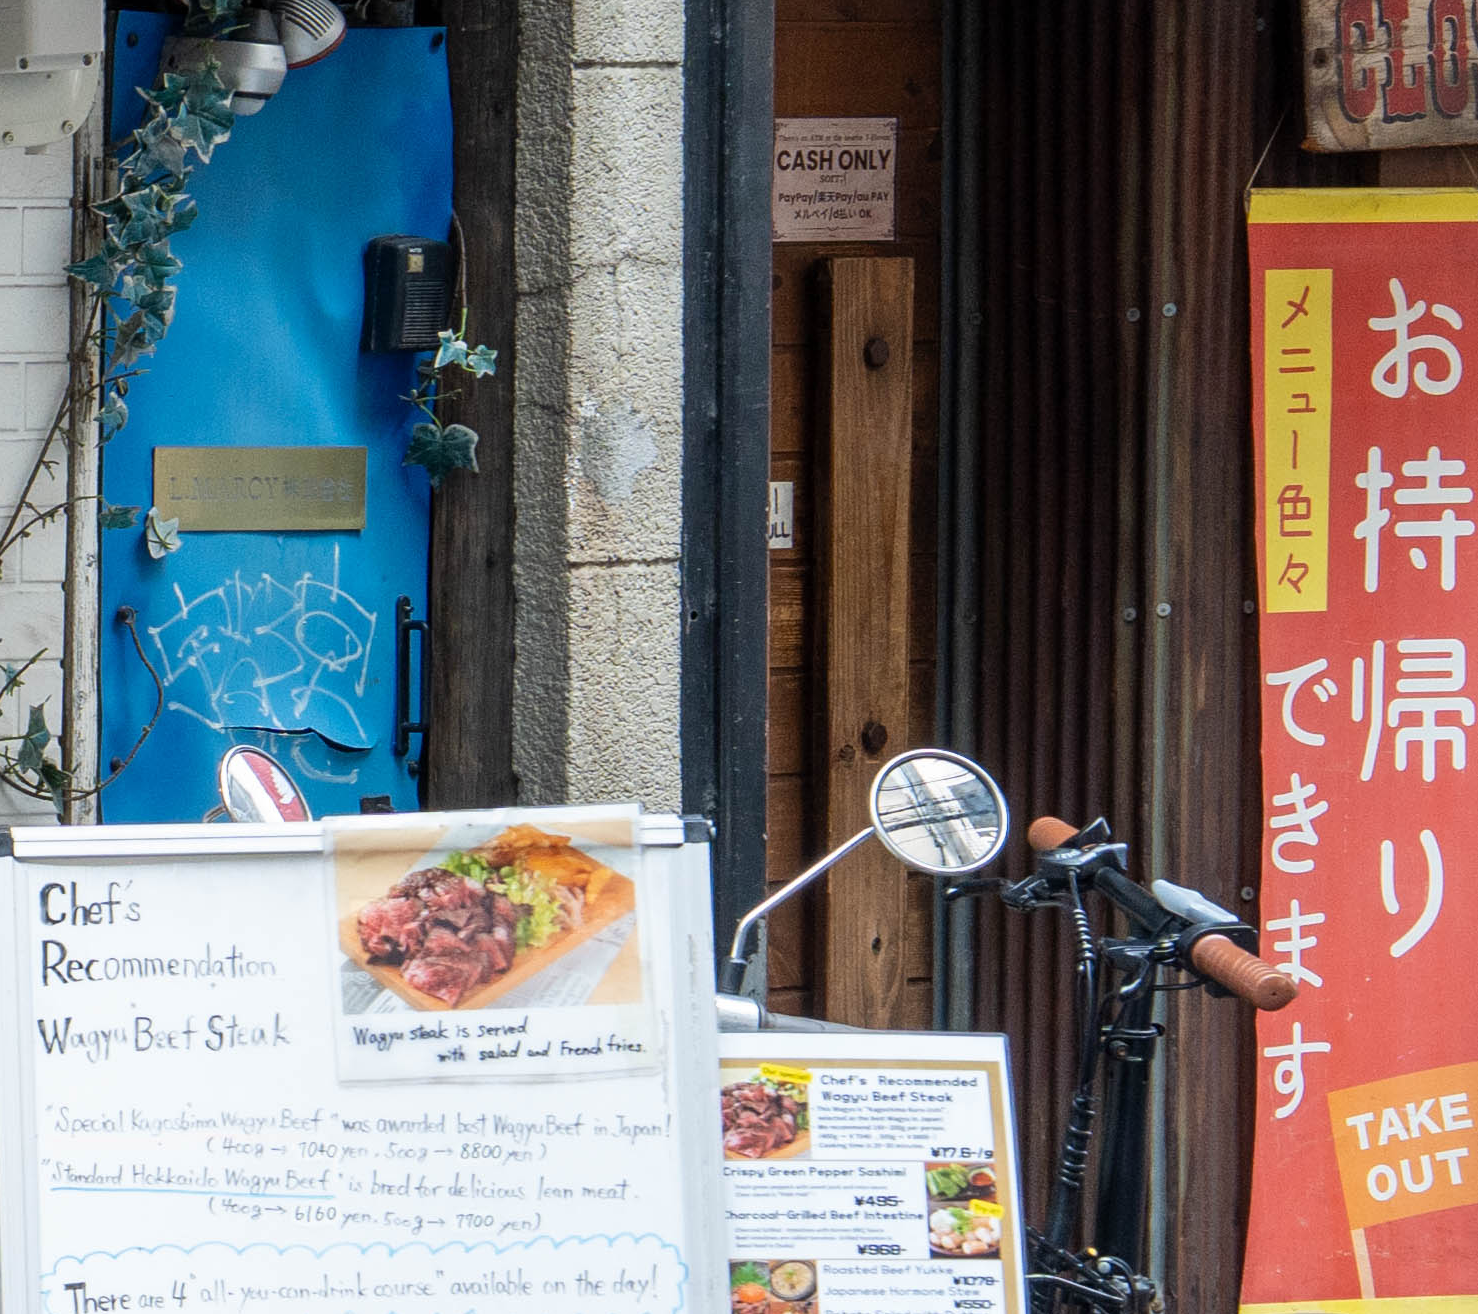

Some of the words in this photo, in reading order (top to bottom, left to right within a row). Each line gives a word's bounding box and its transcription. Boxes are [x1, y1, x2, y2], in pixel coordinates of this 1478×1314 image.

[777, 150, 833, 170] CASH
[838, 150, 891, 170] ONLY
[1276, 286, 1316, 593] メニュー色々
[1352, 277, 1475, 957] お持帰り
[1265, 657, 1337, 1118] できます
[40, 880, 142, 928] Chef's
[41, 940, 277, 987] Recommendation
[38, 1017, 129, 1064] Wagyu
[205, 1013, 291, 1052] Steak
[409, 1020, 448, 1041] steak
[456, 1025, 470, 1038] is
[477, 1015, 528, 1038] served
[478, 1041, 521, 1061] salad
[560, 1037, 603, 1056] French
[879, 1075, 978, 1087] Recommended
[821, 1092, 868, 1103] Wagyu
[872, 1092, 906, 1102] Beef
[910, 1092, 954, 1103] Steak
[1345, 1091, 1475, 1151] TAKE
[448, 1171, 525, 1198] delicious
[768, 1167, 806, 1177] Green
[809, 1167, 854, 1178] Pepper
[859, 1167, 907, 1177] Sashimi
[1366, 1147, 1472, 1203] OUT
[831, 1211, 860, 1220] Beef
[865, 1211, 924, 1220] Intestine
[823, 1265, 877, 1275] Roasted
[881, 1265, 911, 1275] Beef
[138, 1290, 165, 1310] are
[171, 1280, 188, 1309] 4
[449, 1275, 533, 1298] available
[543, 1280, 566, 1296] on
[575, 1272, 606, 1297] the
[824, 1286, 886, 1298] Japanese
